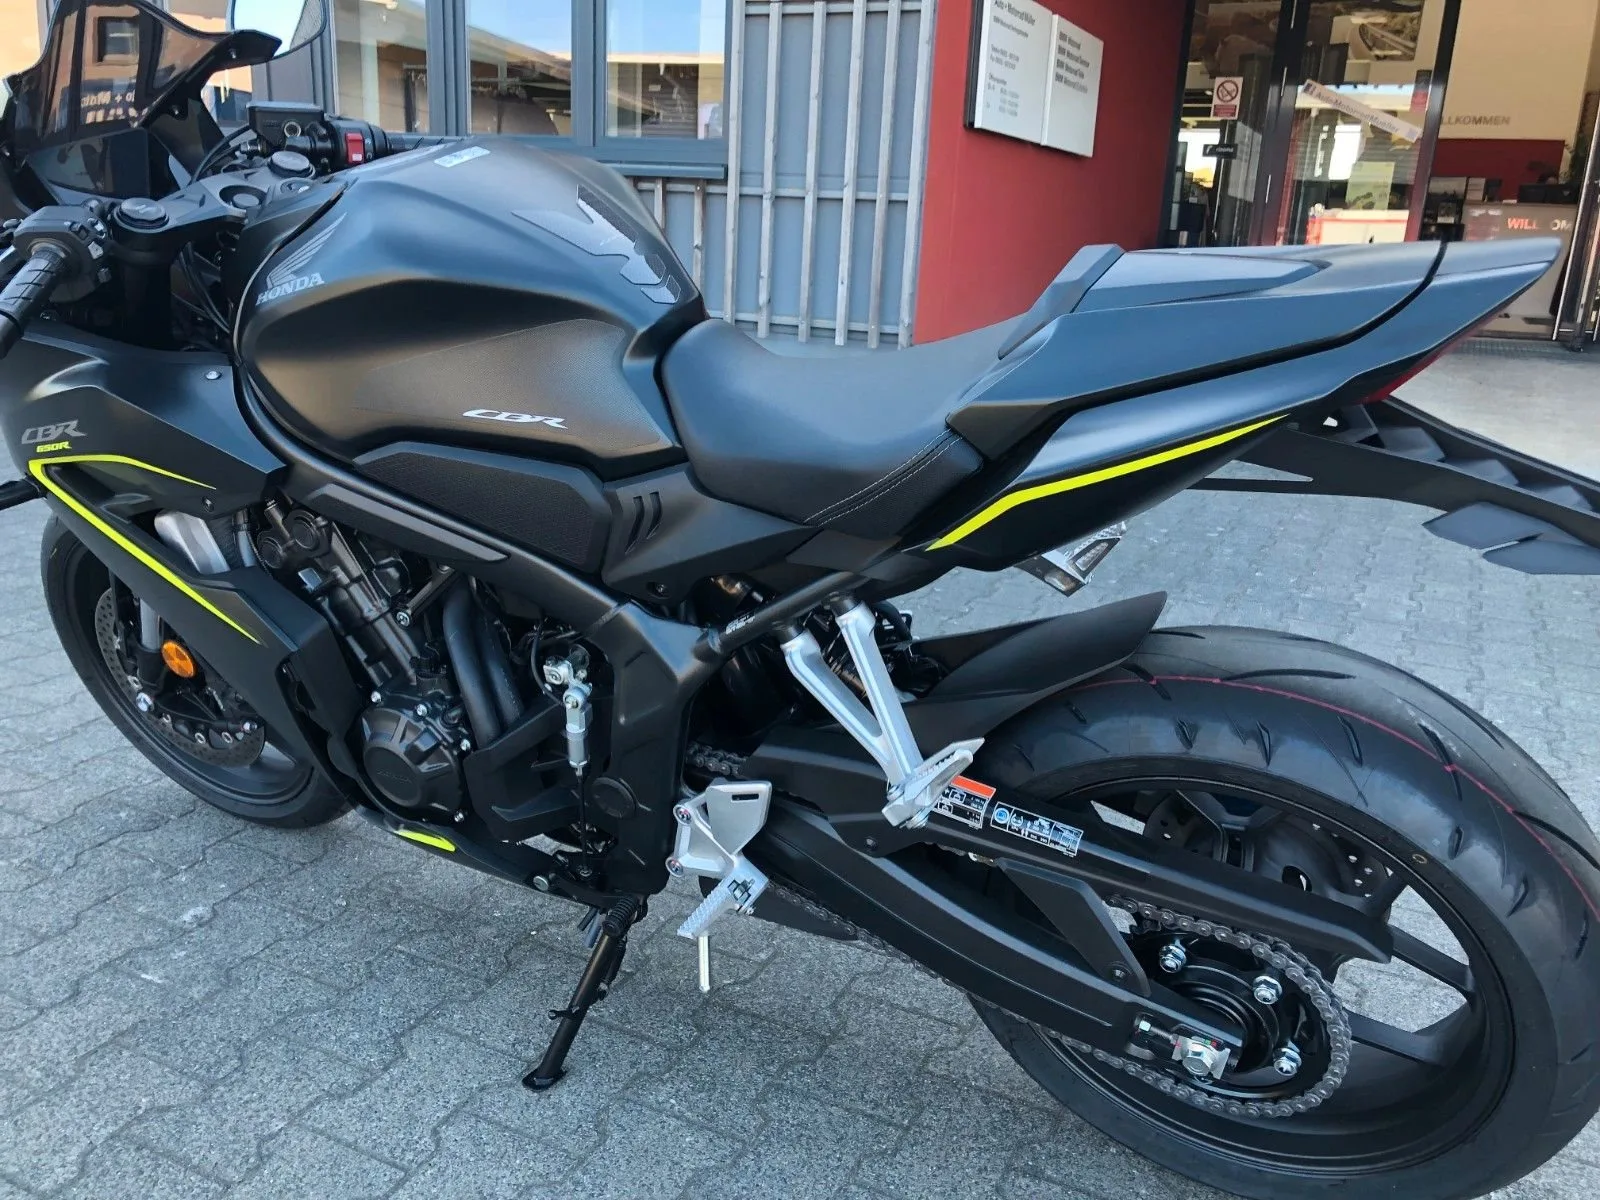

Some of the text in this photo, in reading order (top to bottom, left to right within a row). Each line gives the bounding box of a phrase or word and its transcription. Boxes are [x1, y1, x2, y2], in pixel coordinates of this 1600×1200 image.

[255, 272, 326, 306] HONDA
[462, 408, 569, 430] CBR
[21, 419, 88, 445] CBR
[36, 440, 73, 454] 650R
